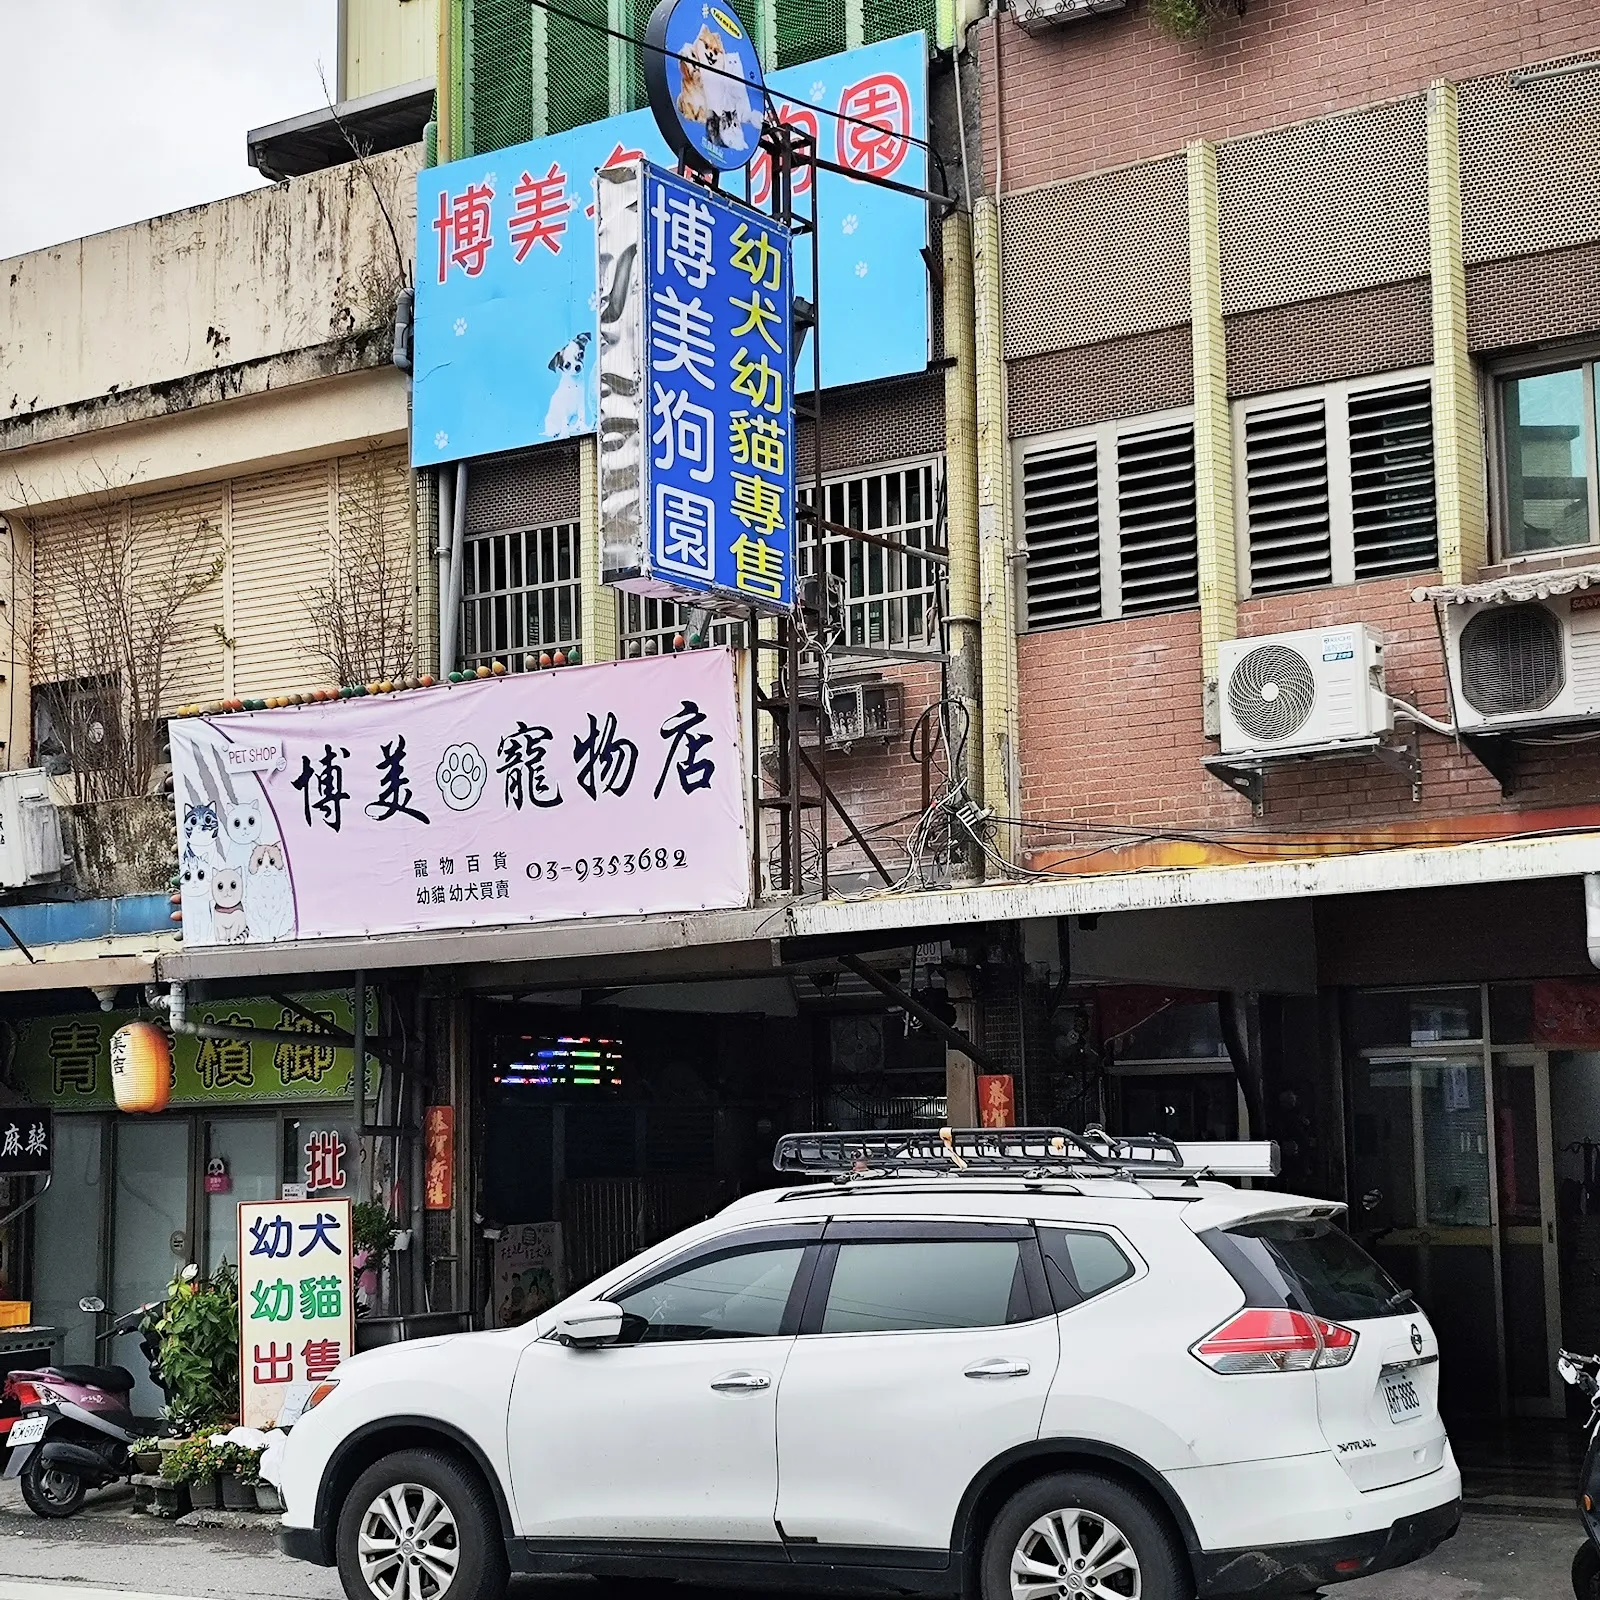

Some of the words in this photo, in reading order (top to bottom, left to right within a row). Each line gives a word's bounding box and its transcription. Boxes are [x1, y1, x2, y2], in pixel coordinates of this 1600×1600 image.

[651, 184, 715, 581] 博美狗園
[729, 222, 785, 599] 幼犬幼貓專售
[228, 749, 247, 764] PET
[249, 746, 276, 763] SHOP
[292, 734, 430, 834] 博美
[496, 700, 714, 809] 寵物店
[413, 851, 508, 878] 寵物百貨
[526, 847, 689, 882] 03-9353682
[1, 1122, 48, 1157] 麻辣
[305, 1132, 346, 1191] 批
[249, 1213, 342, 1258] 幼犬
[250, 1275, 342, 1322] 幼貓
[253, 1338, 341, 1384] 出售
